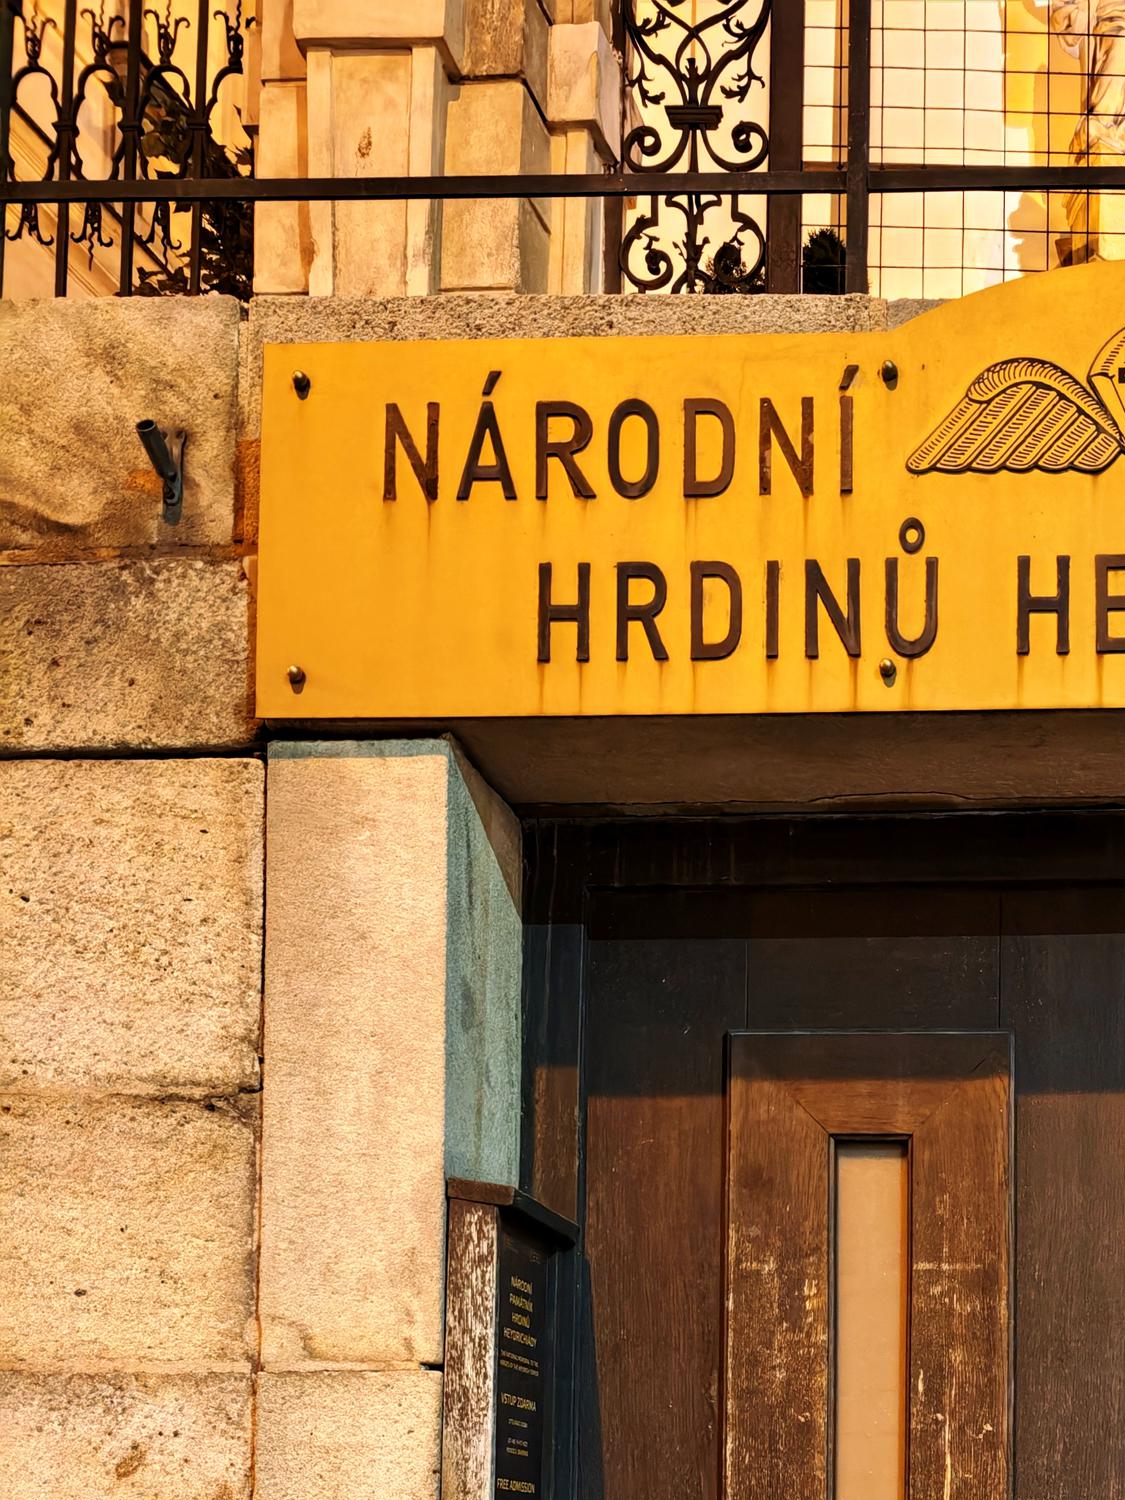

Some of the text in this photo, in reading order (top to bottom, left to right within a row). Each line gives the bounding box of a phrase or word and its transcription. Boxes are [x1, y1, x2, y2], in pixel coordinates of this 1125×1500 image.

[384, 365, 859, 502] NÁRODNÍ
[537, 517, 939, 663] HRDINŮ
[497, 1478, 535, 1494] FREE ADMISSION
